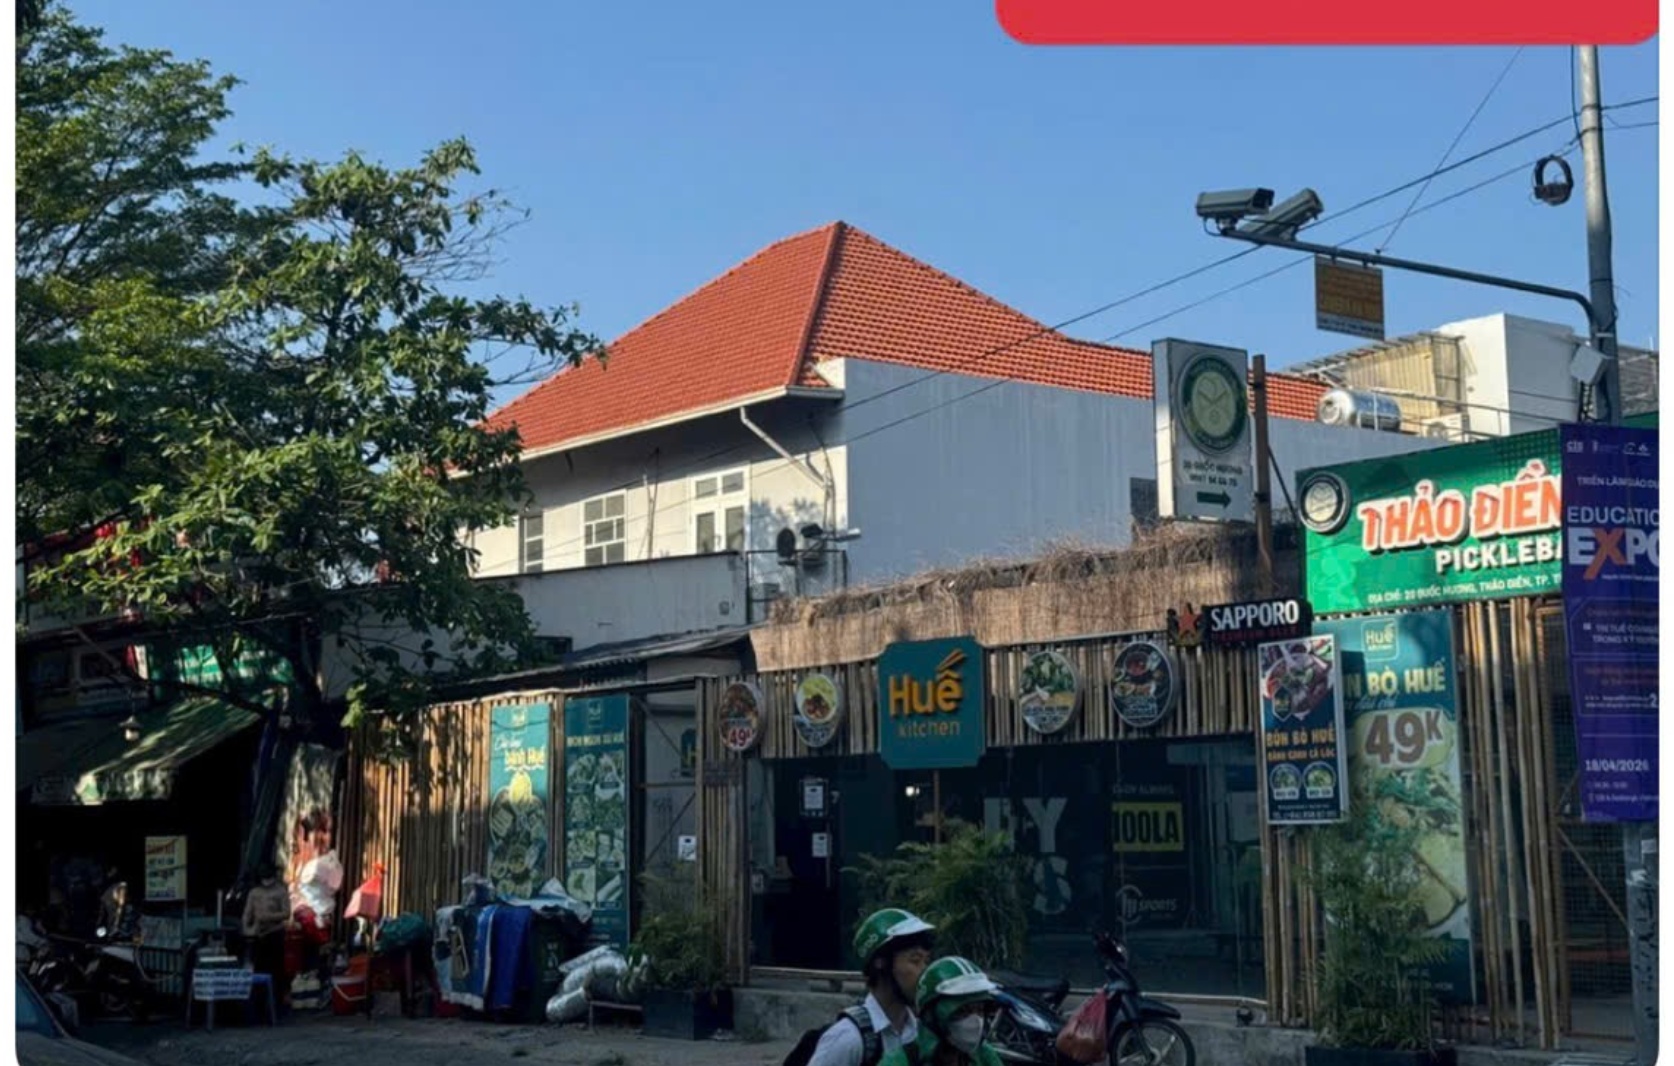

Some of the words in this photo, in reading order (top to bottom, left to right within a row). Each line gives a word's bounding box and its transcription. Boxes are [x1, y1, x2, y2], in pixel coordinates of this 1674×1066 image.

[1358, 480, 1466, 551] THẢO
[1211, 600, 1299, 631] SAPPORO
[889, 649, 966, 717] Huế
[1366, 665, 1398, 696] BÒ
[1404, 657, 1446, 694] HUẾ
[899, 719, 961, 738] kitchen
[1364, 710, 1443, 765] 49K
